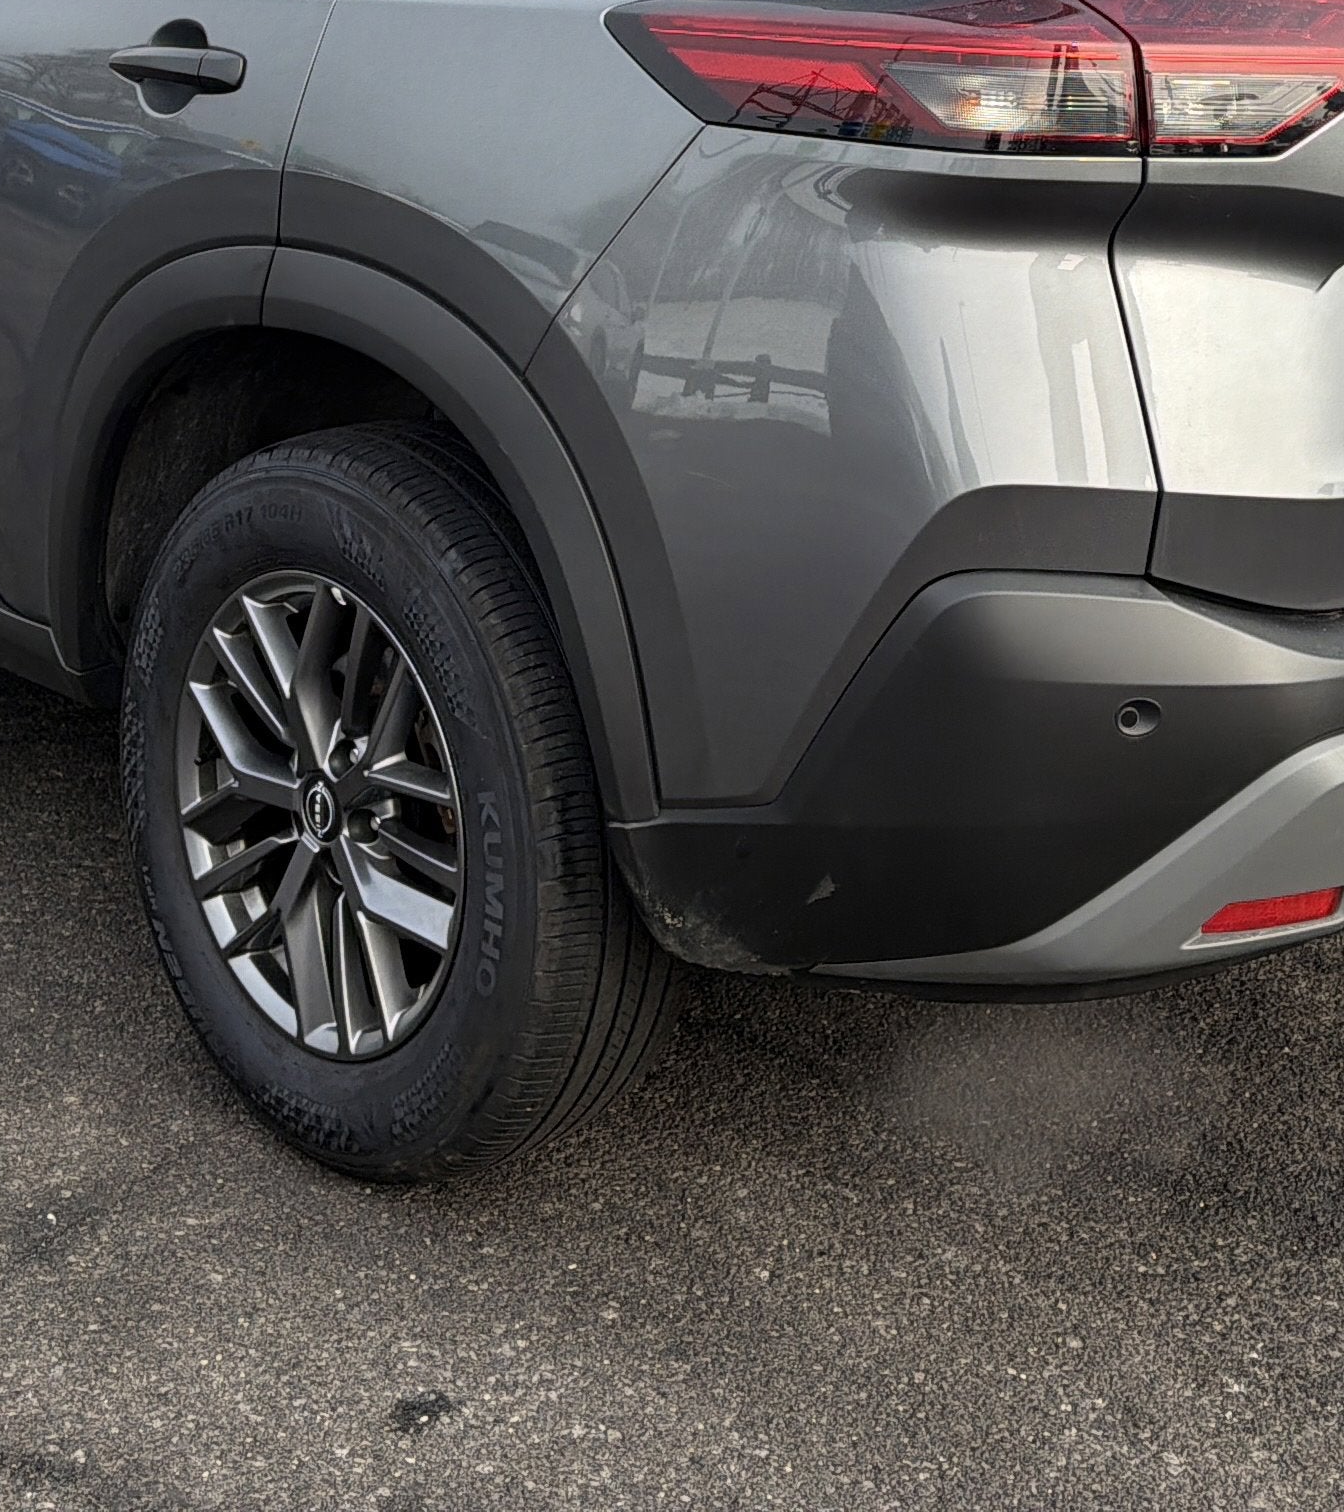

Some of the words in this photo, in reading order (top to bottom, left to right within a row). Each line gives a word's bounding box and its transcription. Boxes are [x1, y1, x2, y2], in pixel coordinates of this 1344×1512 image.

[223, 505, 256, 535] R17
[259, 502, 303, 523] 104H
[475, 791, 505, 997] KUMHO
